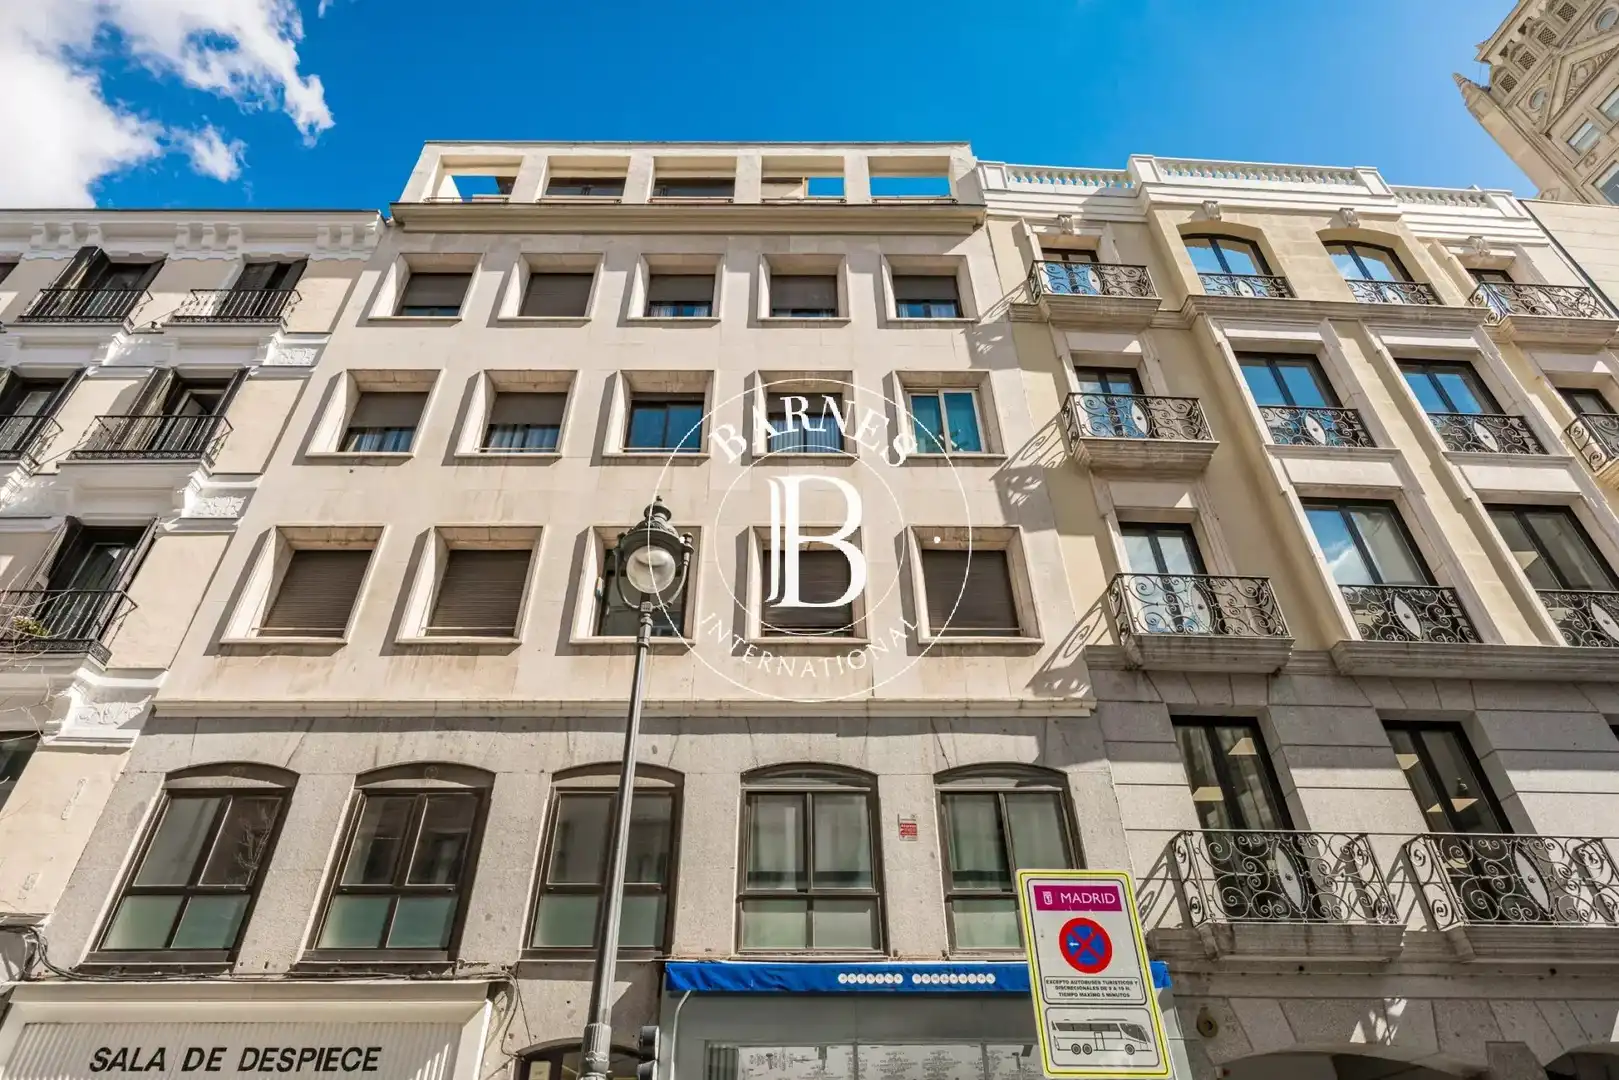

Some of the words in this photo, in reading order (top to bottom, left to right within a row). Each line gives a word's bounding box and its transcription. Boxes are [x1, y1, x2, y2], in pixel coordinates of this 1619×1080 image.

[1060, 892, 1116, 905] MADRID
[89, 1047, 167, 1072] SALA
[181, 1047, 227, 1072] DE
[237, 1047, 382, 1072] DESPIECE
